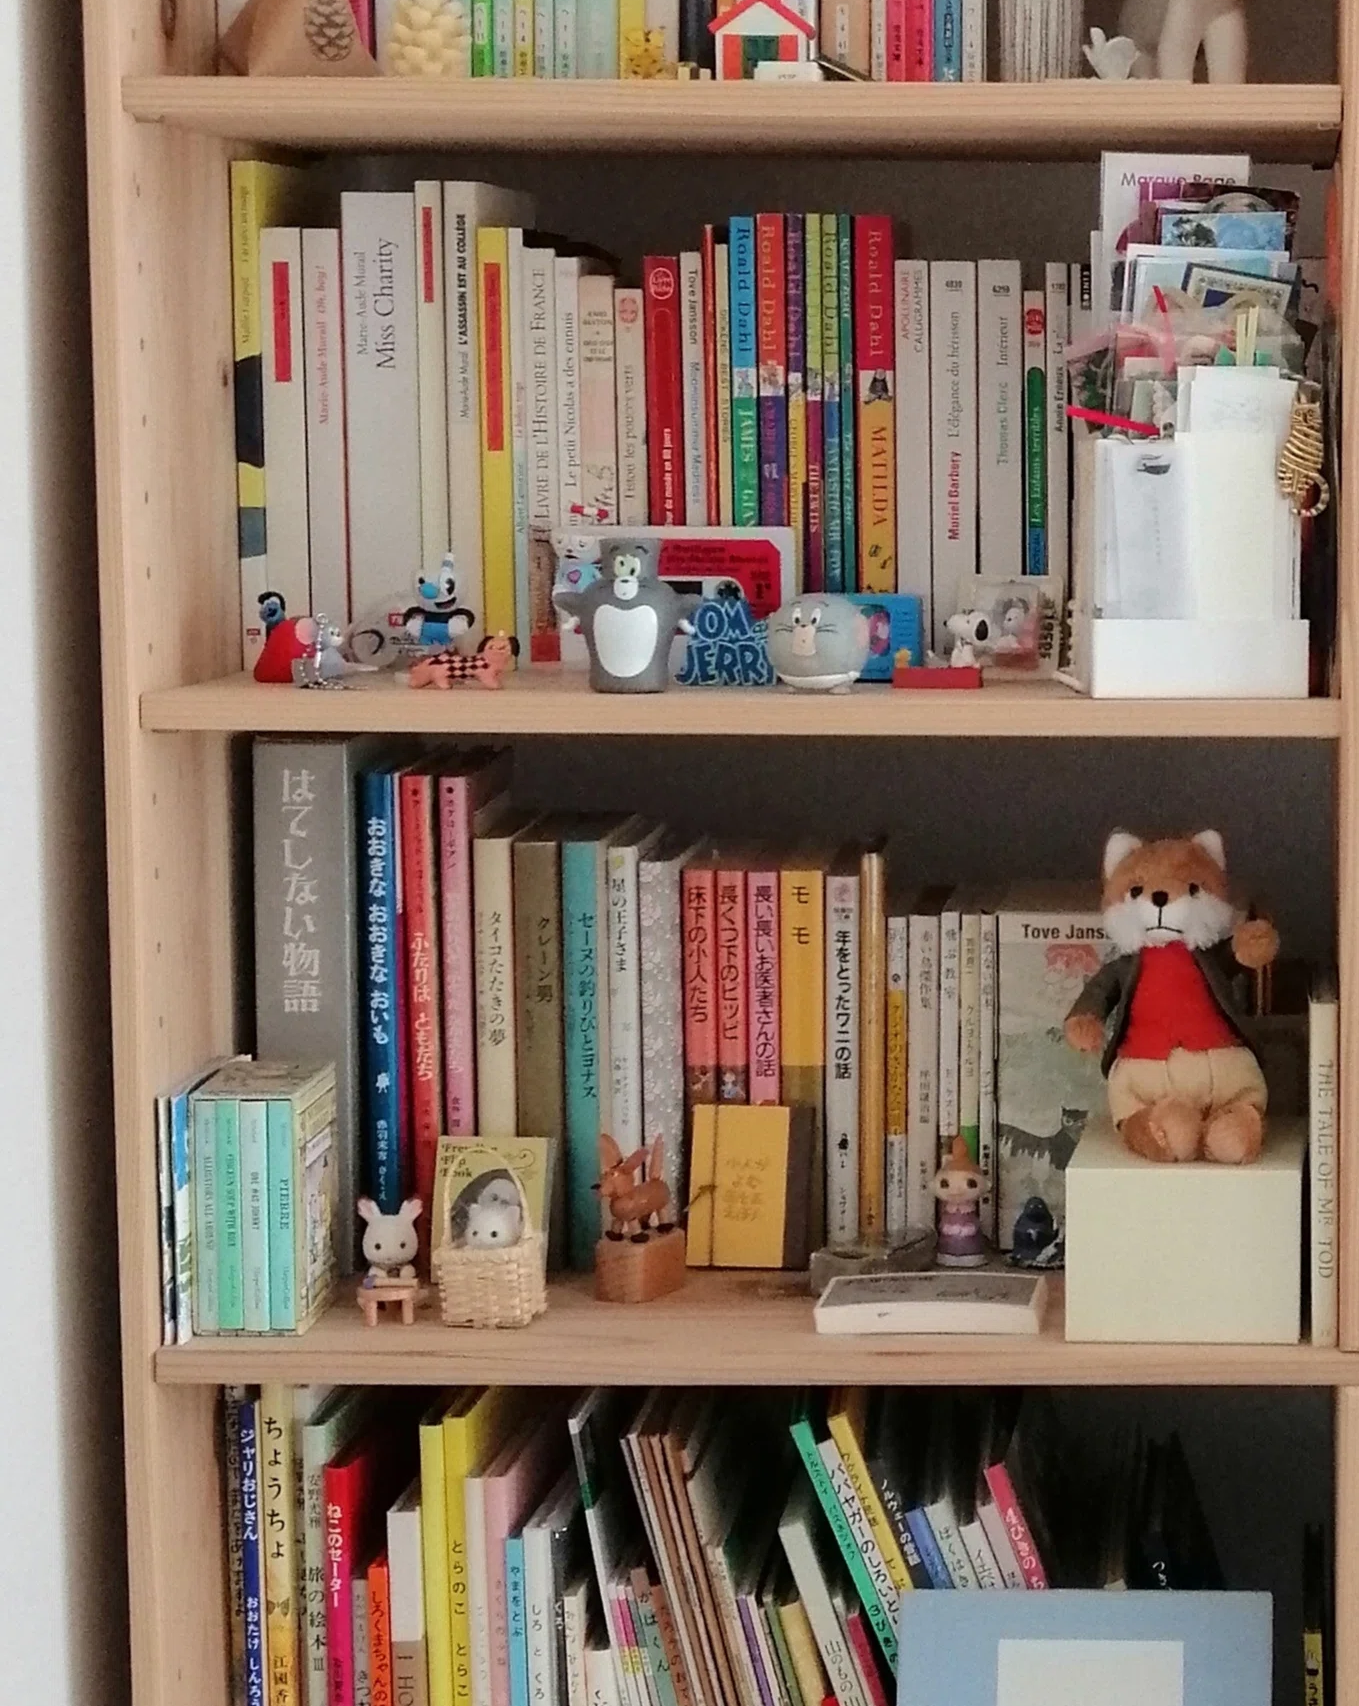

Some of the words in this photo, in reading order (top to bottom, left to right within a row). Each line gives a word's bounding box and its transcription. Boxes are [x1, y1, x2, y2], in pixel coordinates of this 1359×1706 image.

[373, 237, 400, 316] Charity
[687, 269, 697, 291] Tove
[737, 227, 752, 287] Roald
[762, 225, 776, 289] Roald
[868, 229, 883, 294] Roald
[531, 268, 546, 332] FRANCE
[688, 295, 698, 344] Jansson
[737, 300, 752, 352] Dahl
[762, 298, 777, 352] Dahl
[868, 305, 883, 356] Dahl
[902, 270, 910, 341] APOLLINAIRE
[375, 321, 397, 370] Miss
[532, 362, 549, 442] L'HISTOIRE
[565, 386, 577, 432] Nicolas
[565, 435, 580, 466] petit
[871, 425, 887, 527] MATILDA
[949, 450, 962, 497] Barbery
[948, 500, 960, 541] Muriel
[367, 817, 387, 898] おおきな
[281, 768, 320, 1013] はてしない物語
[791, 886, 811, 945] モモ
[368, 903, 389, 983] おおきな
[611, 878, 629, 973] 星の王子さま
[687, 886, 708, 1023] 床下の小人たち
[1022, 924, 1061, 940] Tove
[487, 912, 508, 1046] タイコたたきの夢
[535, 915, 553, 1003] クレーン男
[718, 884, 739, 1041] 長くつ下のピッピ
[754, 884, 777, 1078] 長い長いお医者さんの話
[370, 990, 389, 1044] おいも
[834, 930, 852, 1080] 年をとったワニの話
[415, 1014, 434, 1081] ともだち
[1316, 1059, 1334, 1102] THE
[1316, 1110, 1334, 1163] TALE
[279, 1179, 291, 1230] PIERRE
[1316, 1244, 1334, 1281] TOD
[239, 1429, 257, 1540] ジャリおじさん
[264, 1416, 286, 1559] ちょうちょ
[326, 1503, 344, 1608] ねこのセーター
[451, 1540, 466, 1615] とらのこ
[246, 1596, 260, 1650] おおたけ
[307, 1564, 327, 1650] 旅の絵本
[456, 1643, 469, 1698] とらこ
